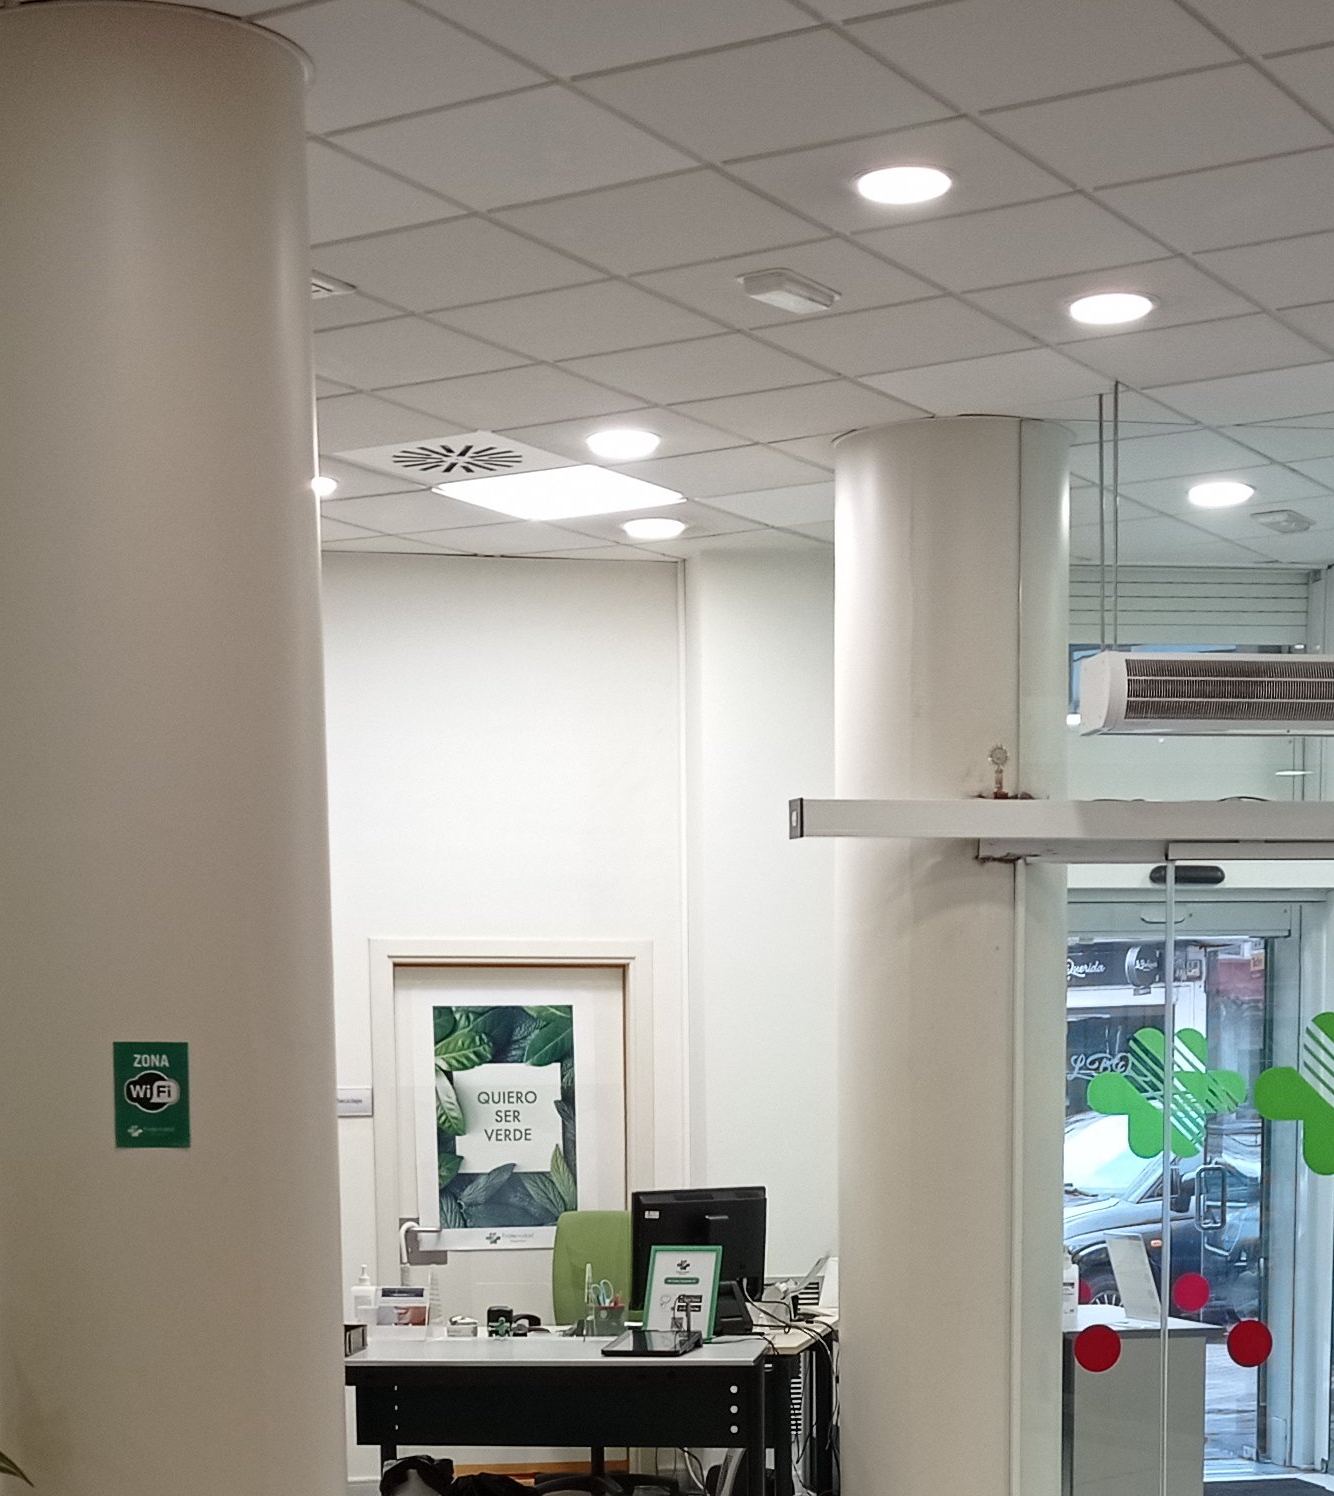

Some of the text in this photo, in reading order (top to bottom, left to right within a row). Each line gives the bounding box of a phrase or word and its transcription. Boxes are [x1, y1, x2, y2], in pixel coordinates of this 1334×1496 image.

[133, 1053, 170, 1068] ZONA
[477, 1090, 538, 1105] QUIERO
[494, 1109, 521, 1123] SER
[484, 1128, 532, 1142] VERDE
